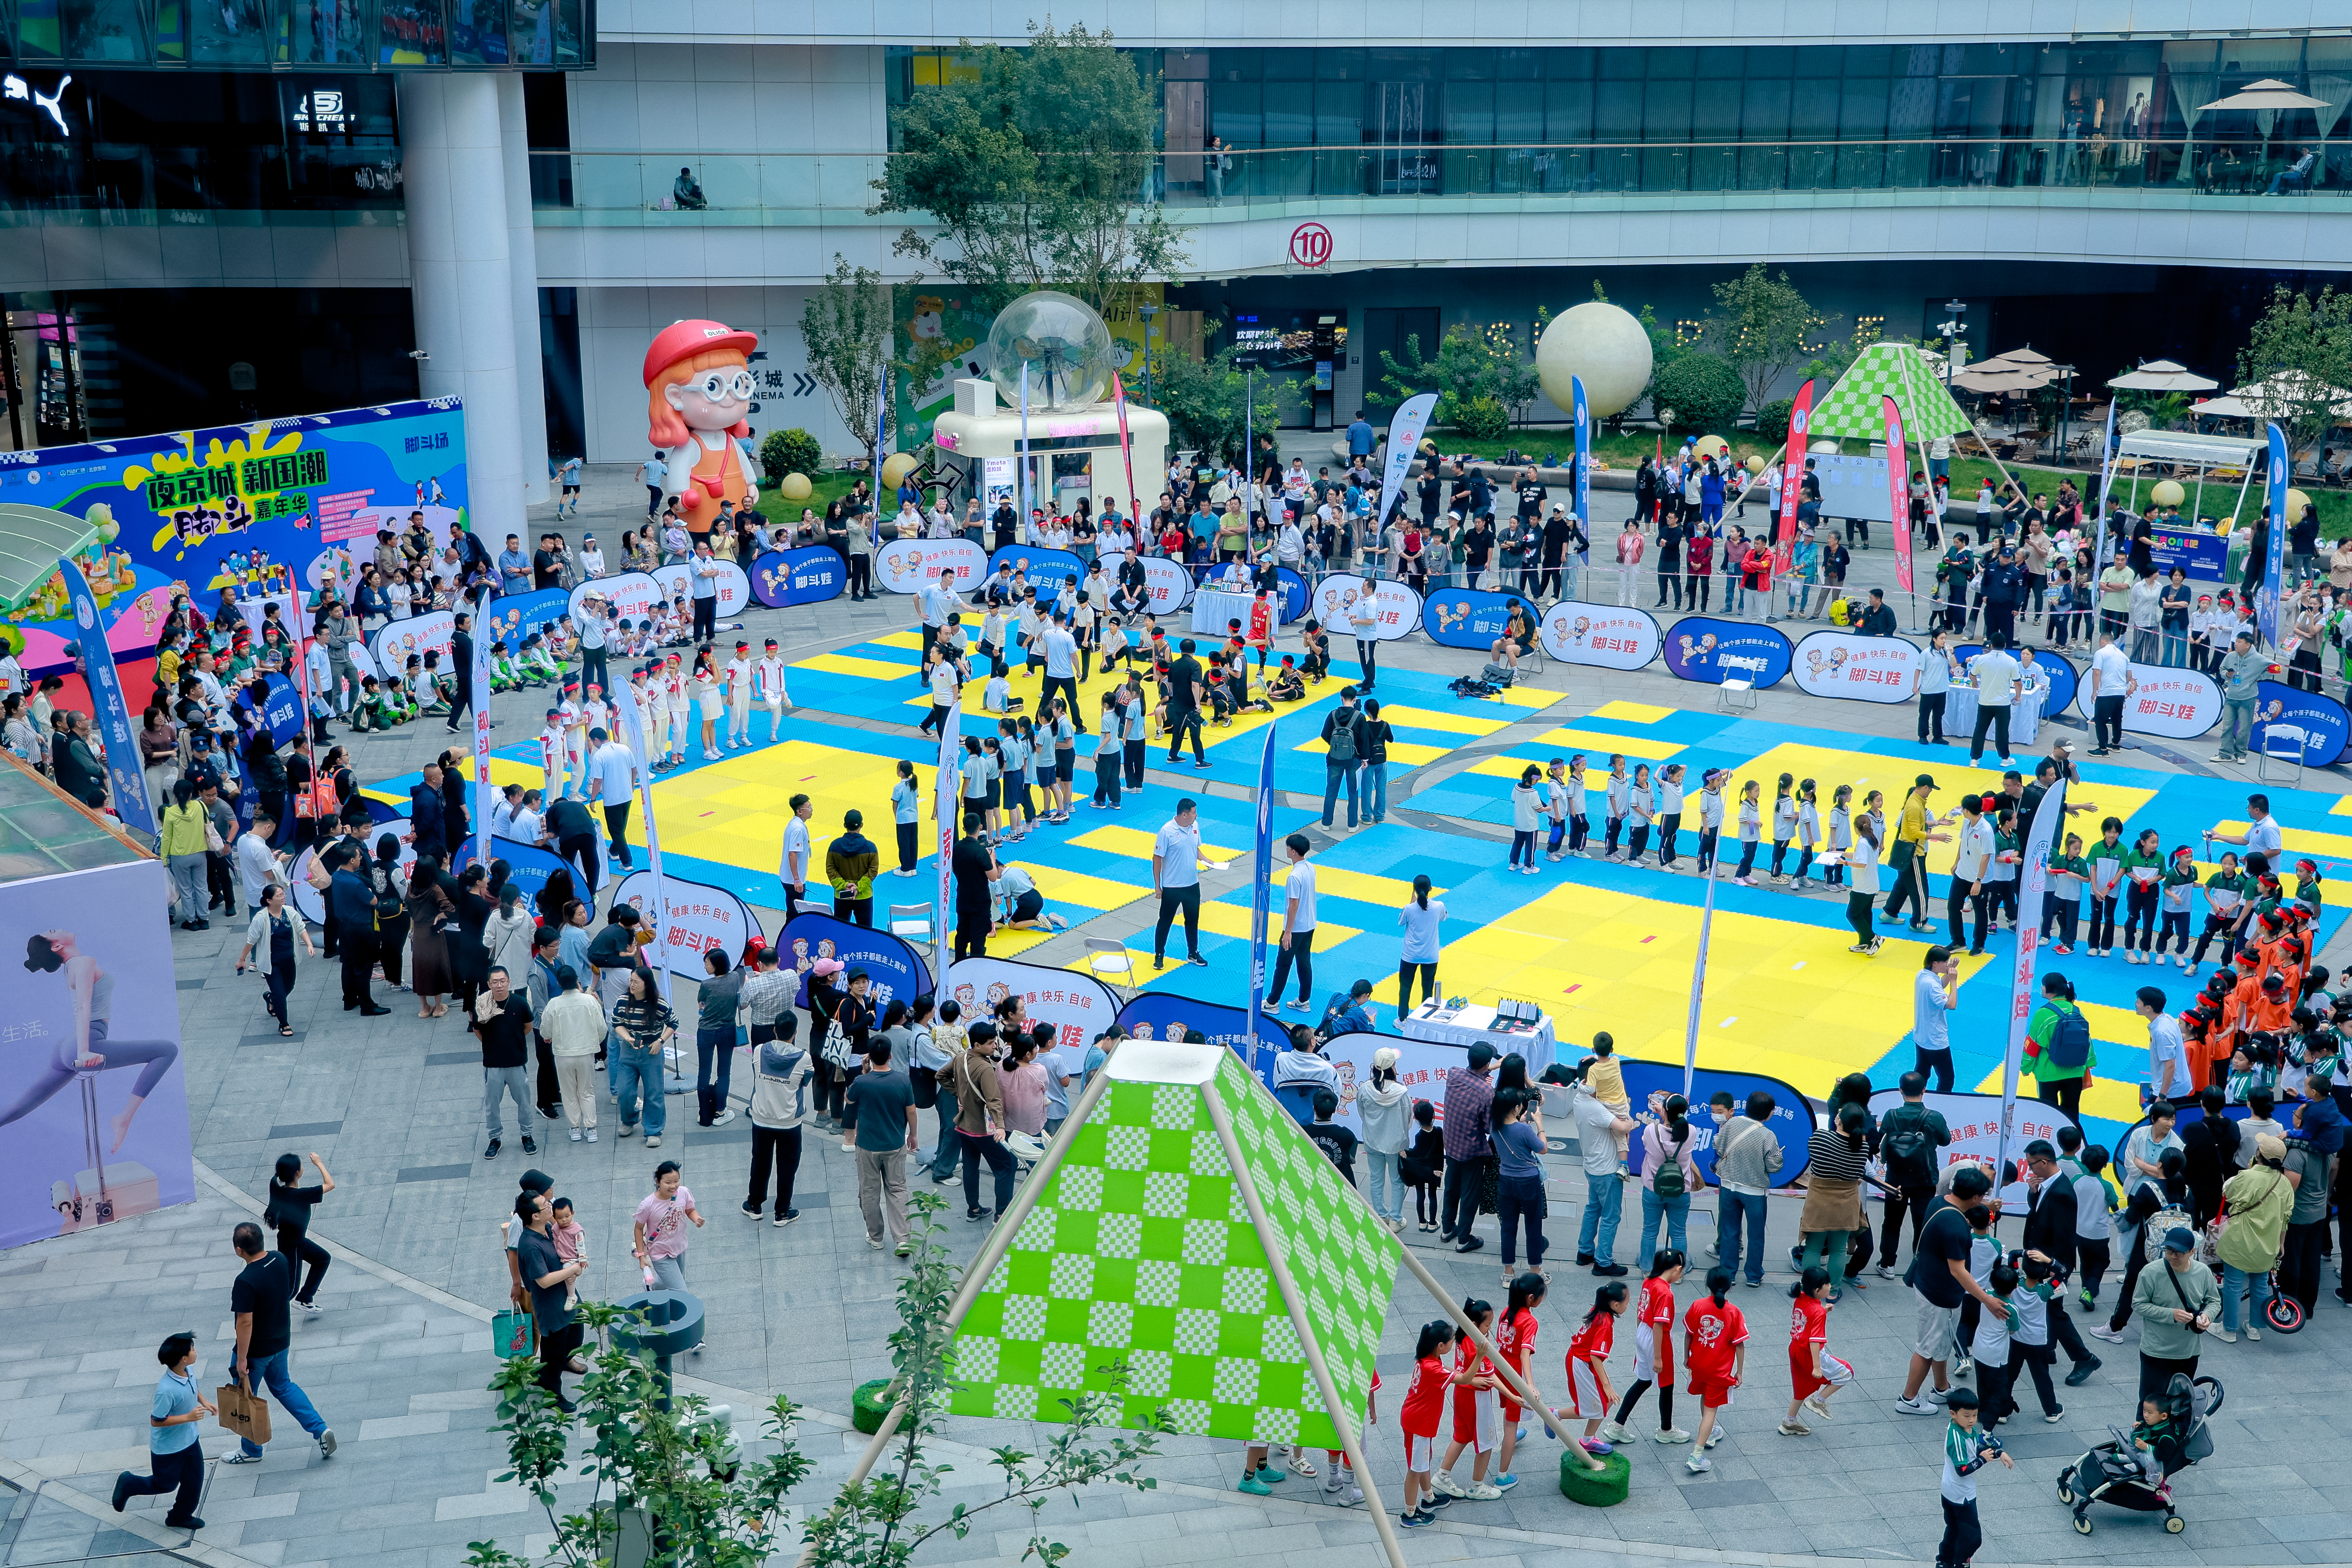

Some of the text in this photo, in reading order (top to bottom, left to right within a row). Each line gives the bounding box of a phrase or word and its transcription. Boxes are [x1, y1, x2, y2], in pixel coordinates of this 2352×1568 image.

[1297, 232, 1326, 258] 10
[404, 432, 449, 453] 脚斗场
[147, 451, 326, 509] 夜京城 新国潮
[1782, 463, 1797, 517] 脚斗娃
[257, 495, 307, 519] 嘉年华
[174, 496, 252, 540] 脚斗
[791, 557, 836, 574] 让每个孩子都能走上赛场
[926, 552, 940, 563] 健康
[926, 566, 970, 578] 脚娃
[1029, 562, 1078, 572] 让每个孩子都能走上赛场
[1161, 569, 1174, 579] 自信
[622, 584, 635, 594] 快乐
[636, 582, 648, 590] 自信
[796, 572, 832, 589] 脚斗娃
[1148, 587, 1169, 600] 斗娃
[1392, 593, 1406, 603] 自信
[417, 621, 454, 643] 健康 快乐 自信
[1473, 620, 1504, 635] 脚斗
[1593, 619, 1643, 631] 健康 快乐 自信
[1591, 636, 1639, 654] 脚斗娃
[1717, 638, 1781, 649] 让每个孩子都能走上赛场
[1850, 650, 1908, 662] 健康 快乐 自信
[1849, 667, 1902, 686] 脚斗娃
[2141, 681, 2203, 694] 健康 快乐 自信
[270, 703, 295, 729] 脚斗娃
[2138, 699, 2196, 720] 脚斗娃
[2281, 709, 2342, 726] 让每个孩子都能走上赛场
[672, 904, 731, 924] 健康 快乐 自信
[836, 952, 907, 974] 让每个孩子都能走上赛场
[1042, 990, 1064, 1003] 快乐
[1070, 992, 1093, 1009] 自信
[1403, 1068, 1448, 1087] 健康 快
[1984, 1121, 1999, 1134] 快
[2023, 1122, 2053, 1139] 自信
